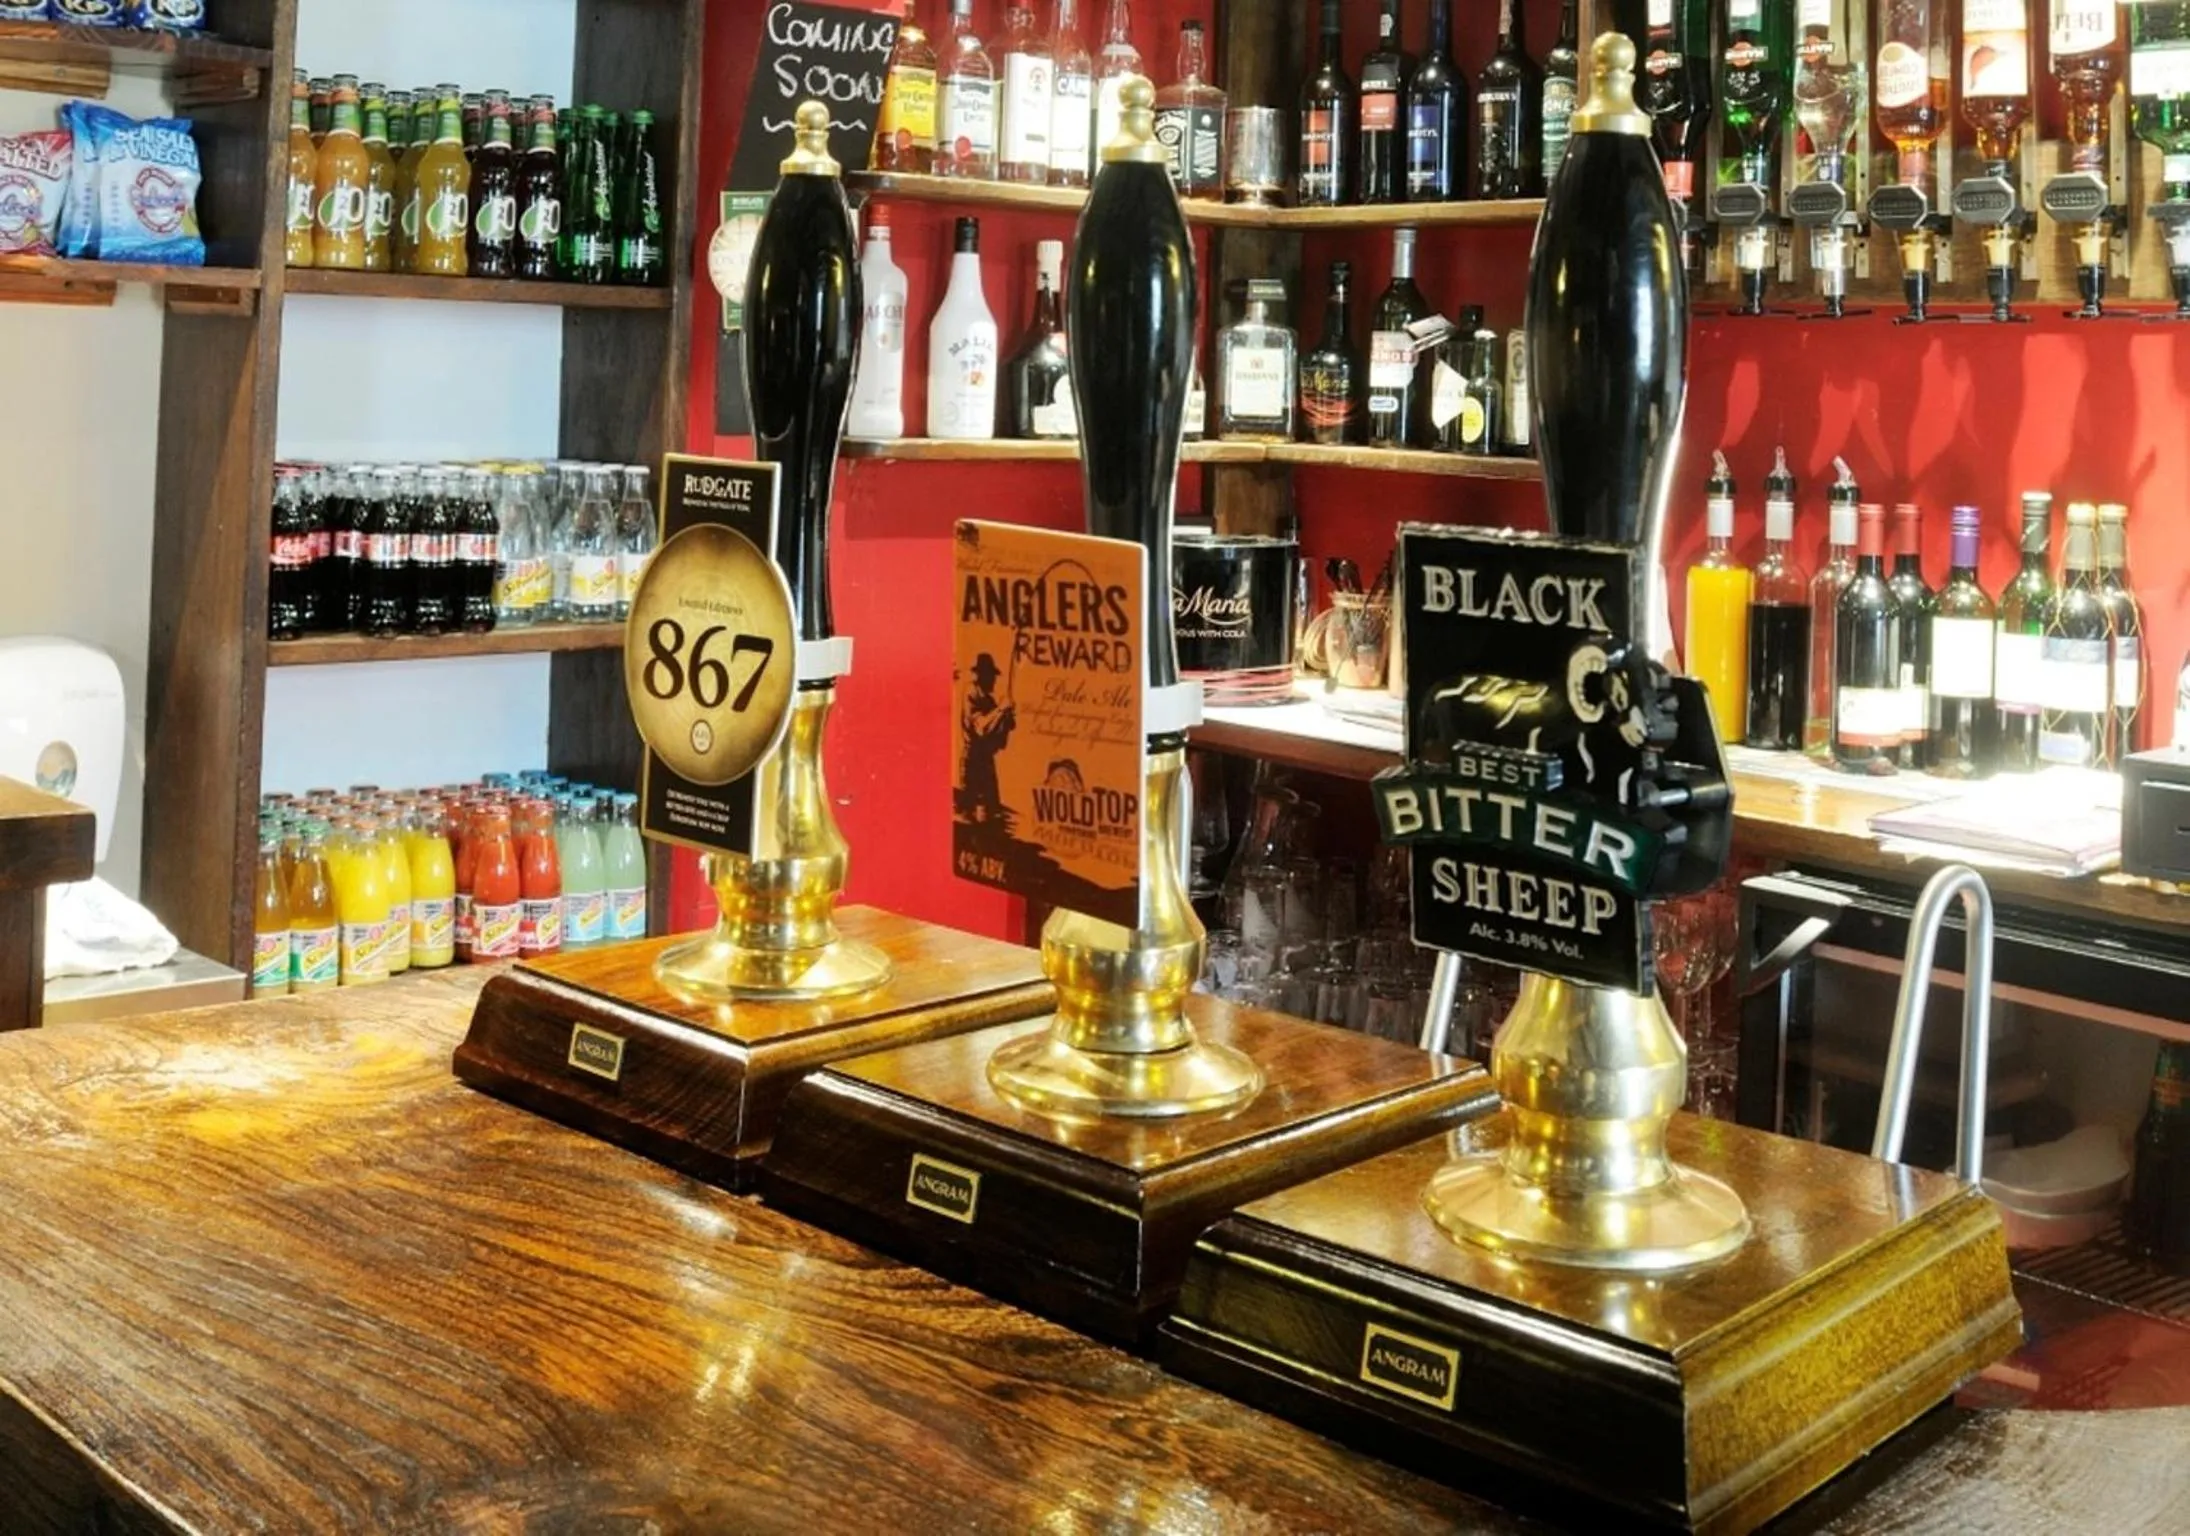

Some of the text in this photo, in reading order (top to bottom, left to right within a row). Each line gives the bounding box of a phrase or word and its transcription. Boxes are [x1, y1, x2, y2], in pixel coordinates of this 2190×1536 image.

[0, 148, 62, 180] ALTED
[683, 473, 753, 501] RUDGATE
[961, 574, 1130, 637] ANGLERS
[1421, 565, 1611, 633] BLACK
[642, 617, 774, 714] 867
[1013, 629, 1133, 675] REWARD
[1458, 752, 1542, 788] BEST
[1384, 784, 1636, 882] BITTER
[1431, 856, 1618, 936] SHEEP
[1469, 921, 1585, 961] Alc. 3.8% Vol.
[915, 1174, 971, 1205] ANGRAM
[1371, 1347, 1447, 1388] ANGRAM
